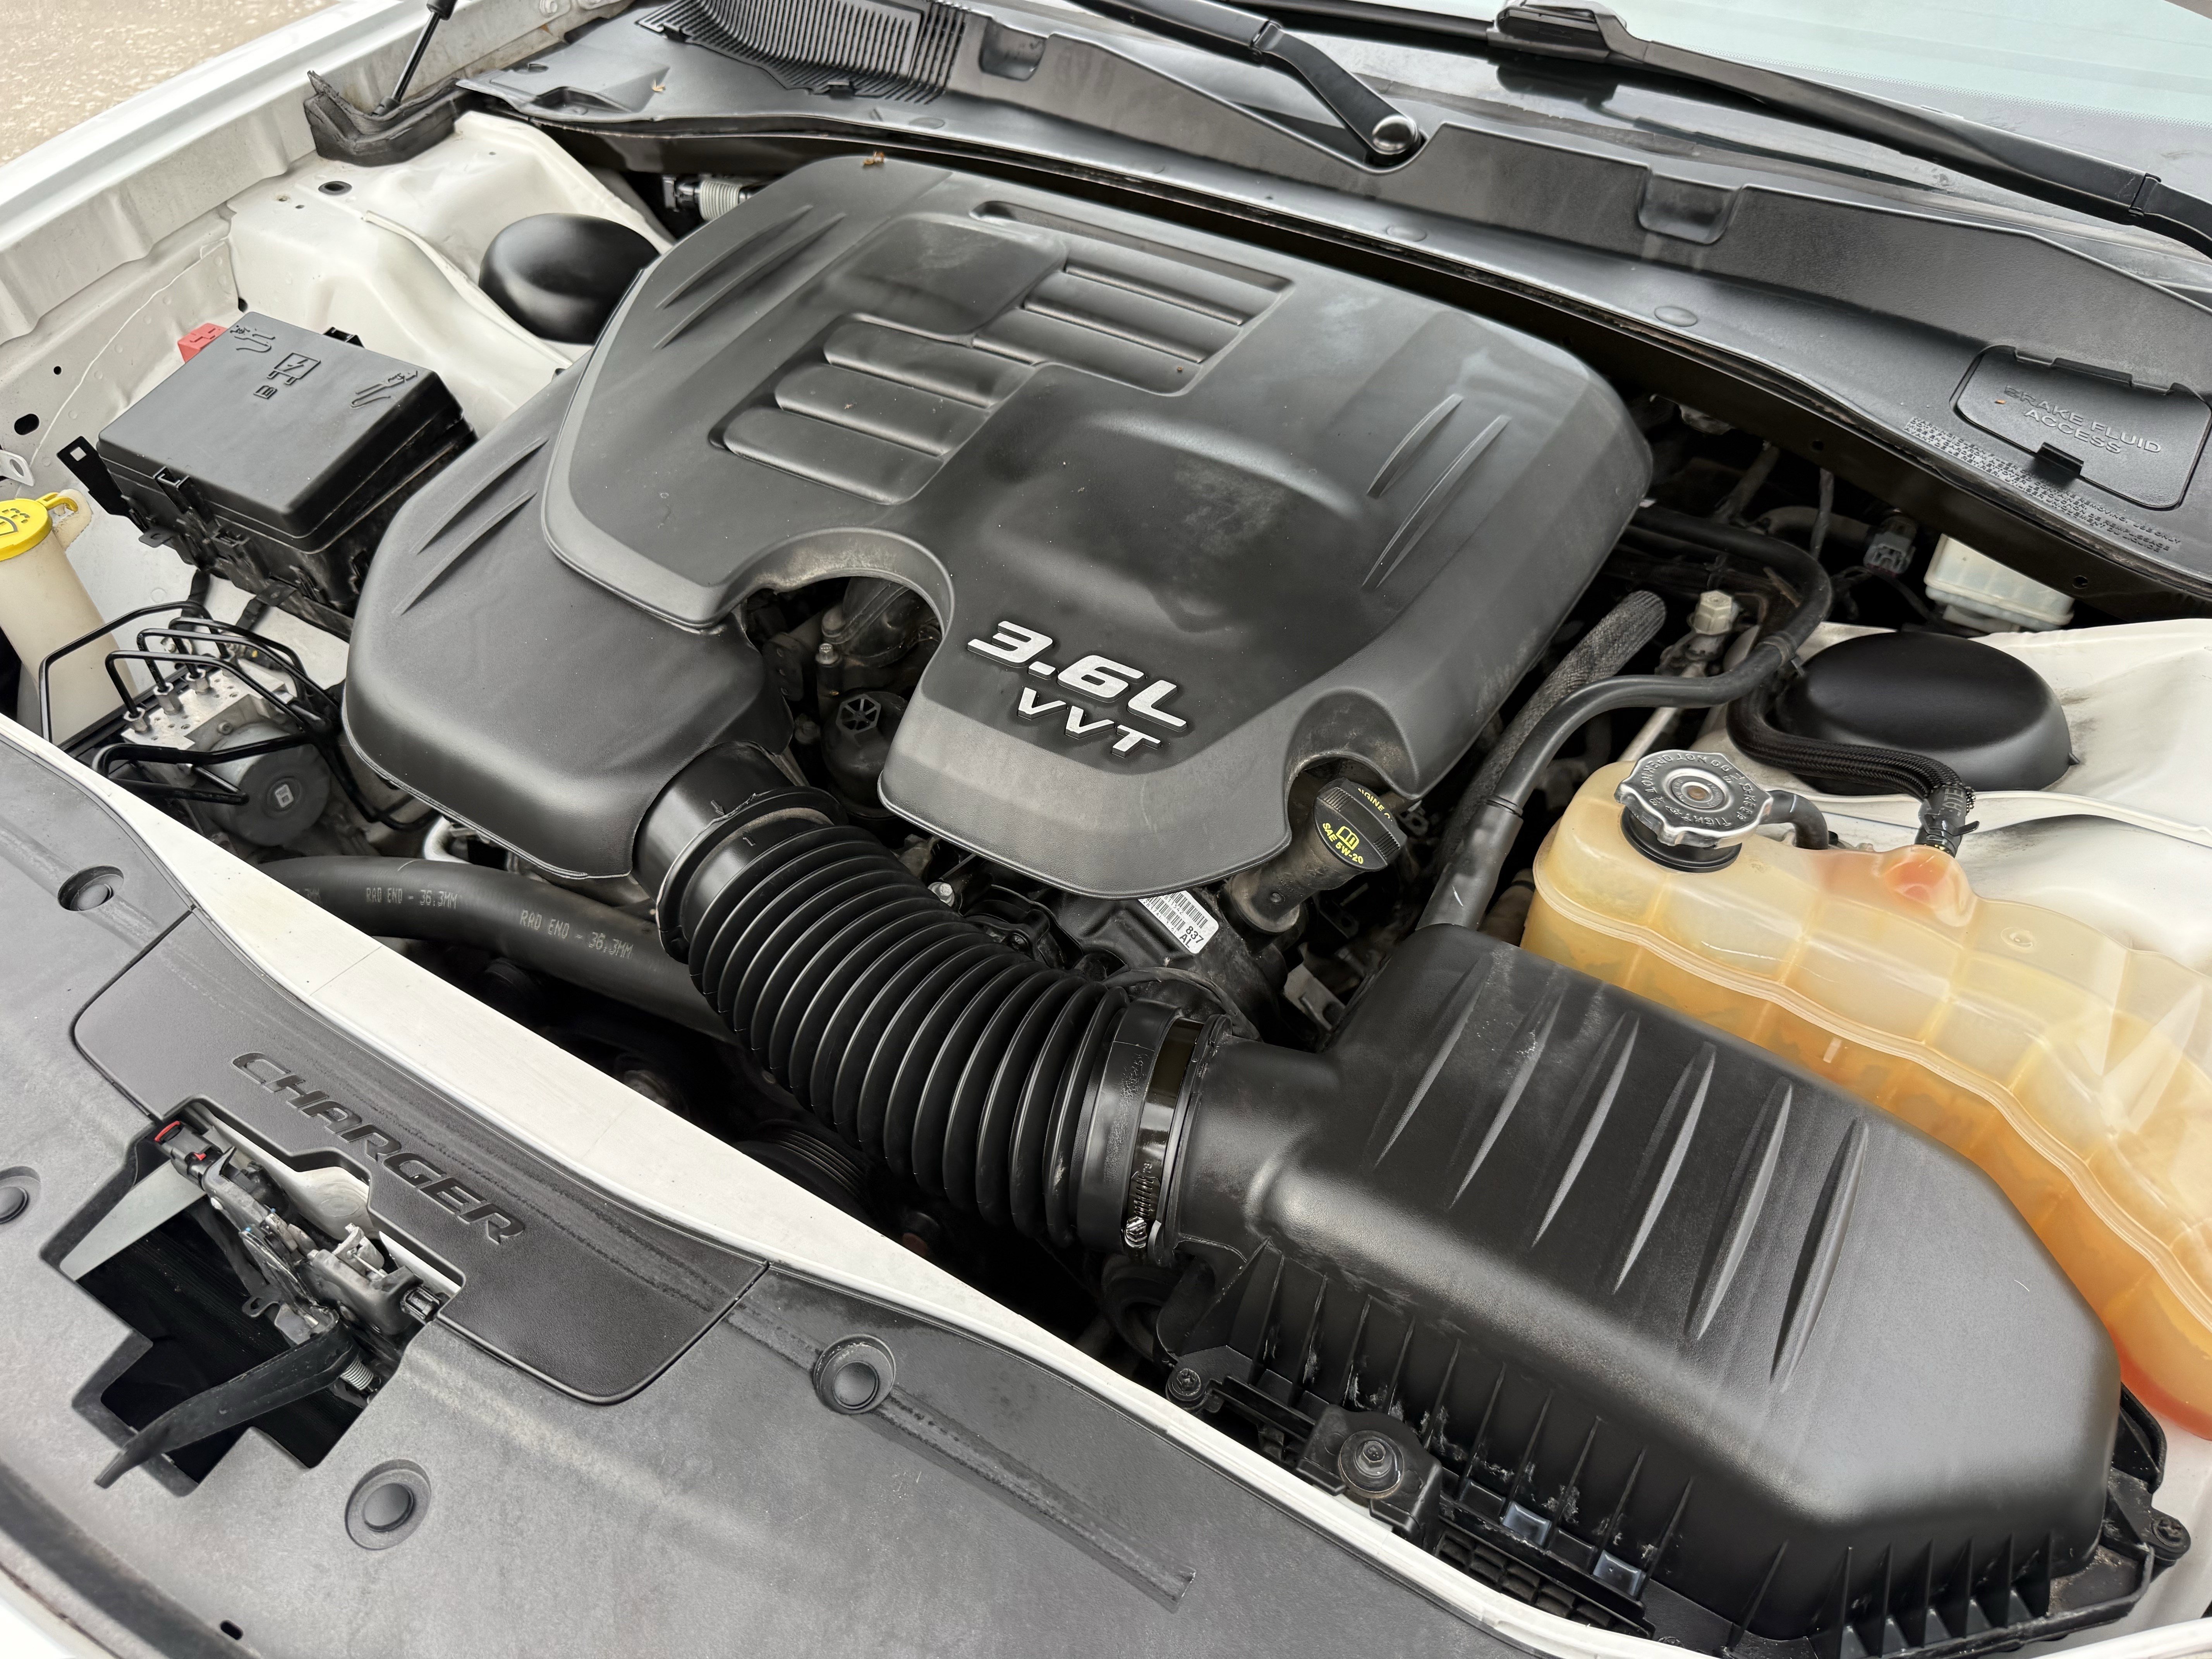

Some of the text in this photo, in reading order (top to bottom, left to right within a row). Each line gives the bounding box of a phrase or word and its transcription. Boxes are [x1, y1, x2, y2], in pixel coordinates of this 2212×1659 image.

[2003, 385, 2162, 453] BRAKE FLUID
[2024, 409, 2121, 454] ACCESS
[2154, 531, 2181, 544] ONLY
[967, 620, 1188, 732] 3.6L
[1018, 687, 1162, 758] VVT
[1322, 822, 1364, 864] SAE 5W-20
[366, 886, 382, 903] RAD
[387, 887, 403, 903] END
[419, 889, 458, 909] 36.3MM
[520, 910, 542, 930] RAD
[548, 918, 570, 939] END
[587, 931, 634, 960] 36.3MM
[1179, 933, 1191, 948] AL
[1185, 925, 1204, 944] 837
[231, 1052, 526, 1245] CHARGER
